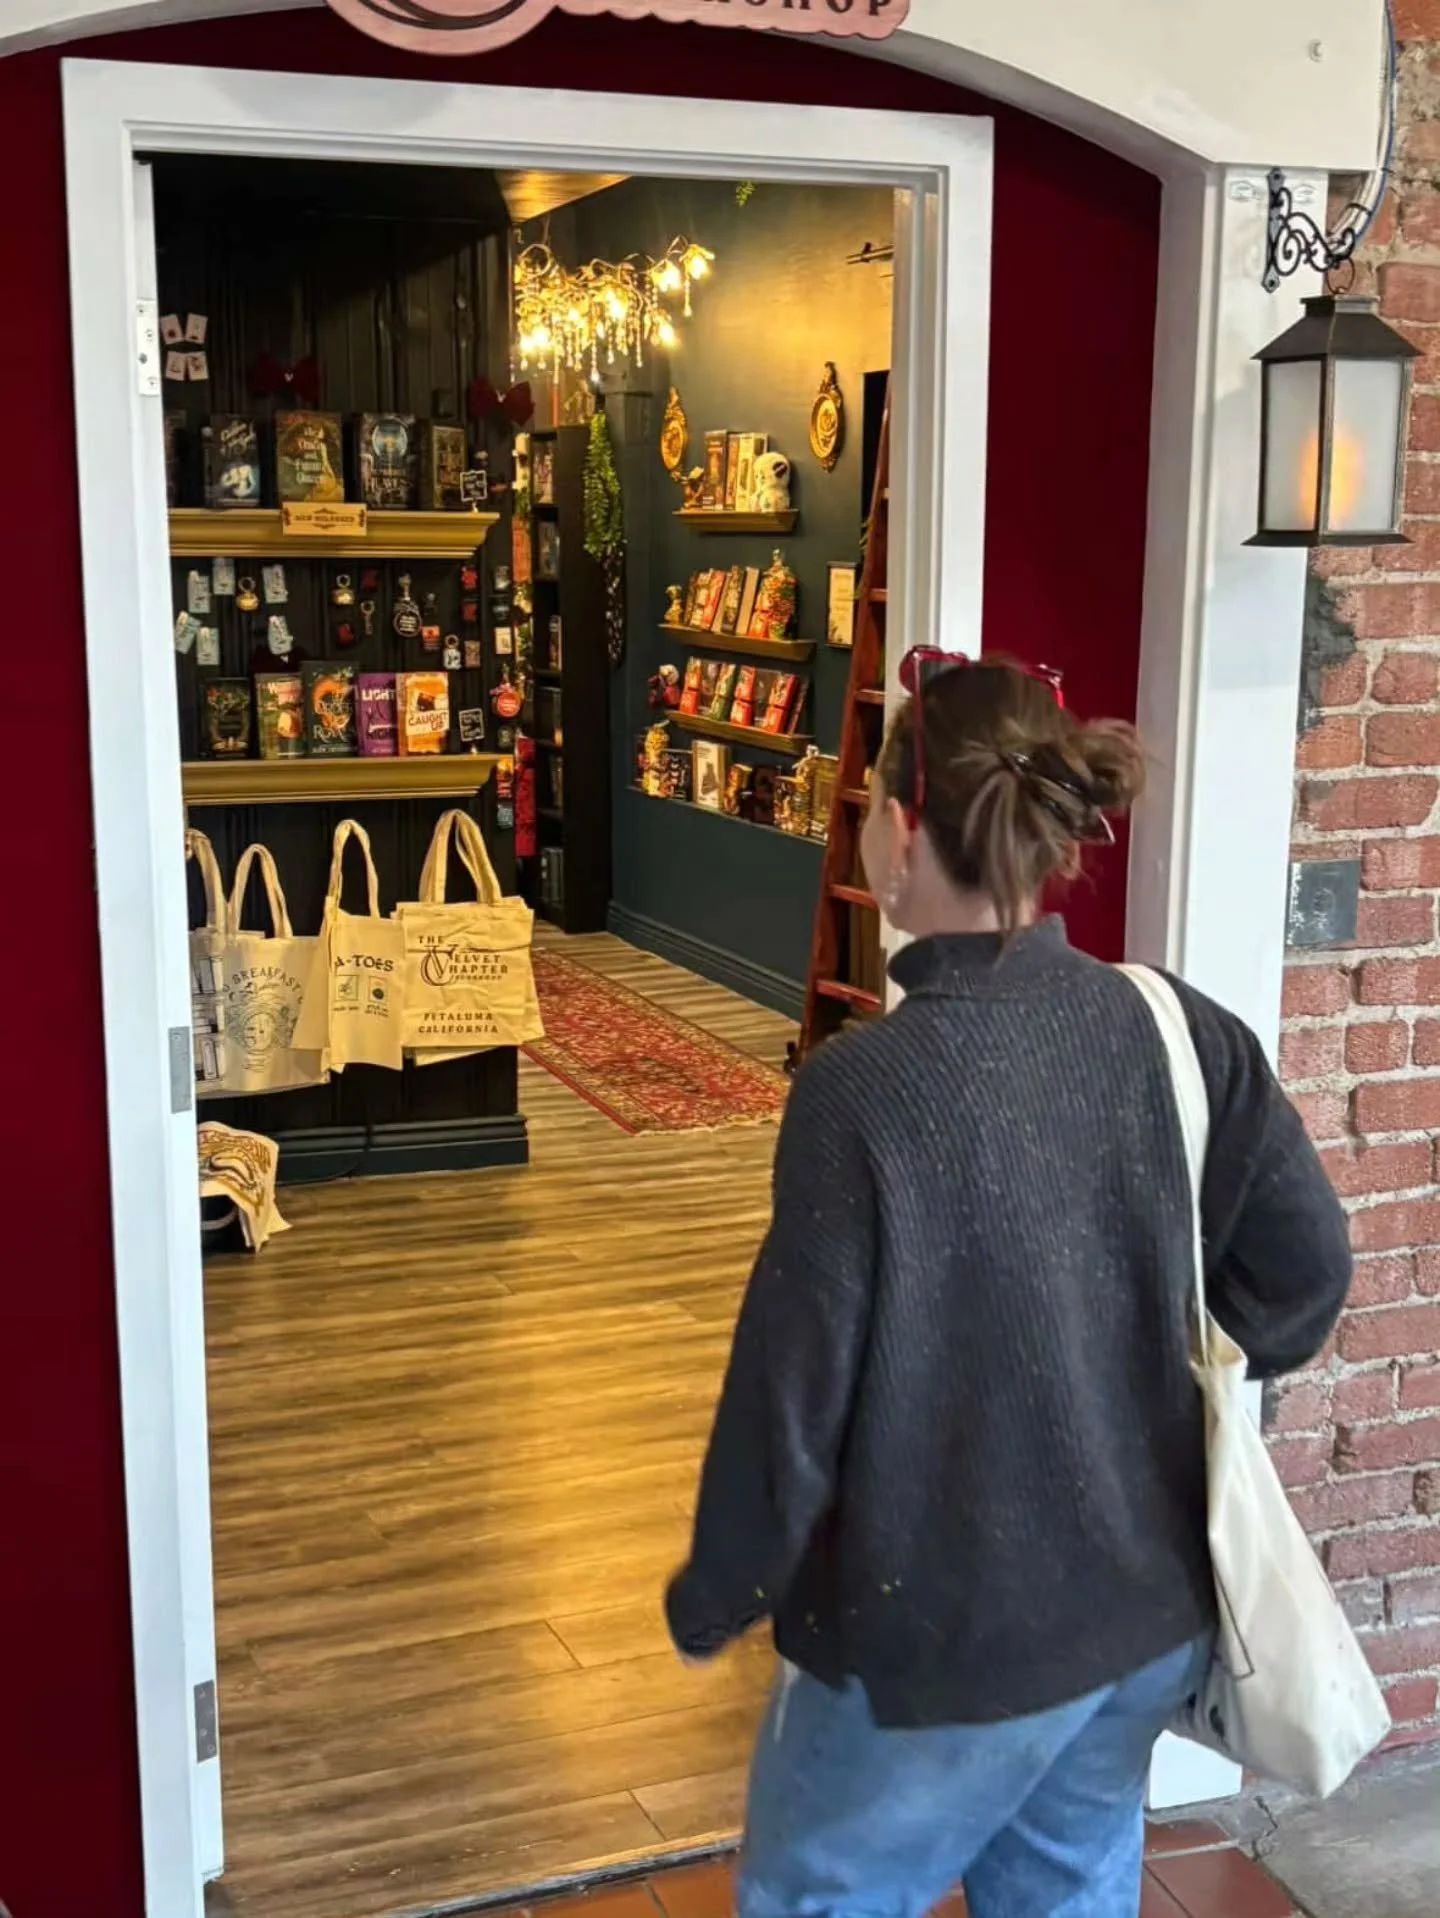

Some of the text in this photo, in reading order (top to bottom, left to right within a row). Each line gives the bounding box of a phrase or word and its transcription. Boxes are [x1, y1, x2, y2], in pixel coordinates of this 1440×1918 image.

[361, 687, 396, 701] LIGHT
[408, 711, 448, 727] CAUGHT
[418, 935, 445, 944] THE
[423, 1012, 494, 1021] PETALUMA
[417, 1024, 499, 1034] CALIFORNIA
